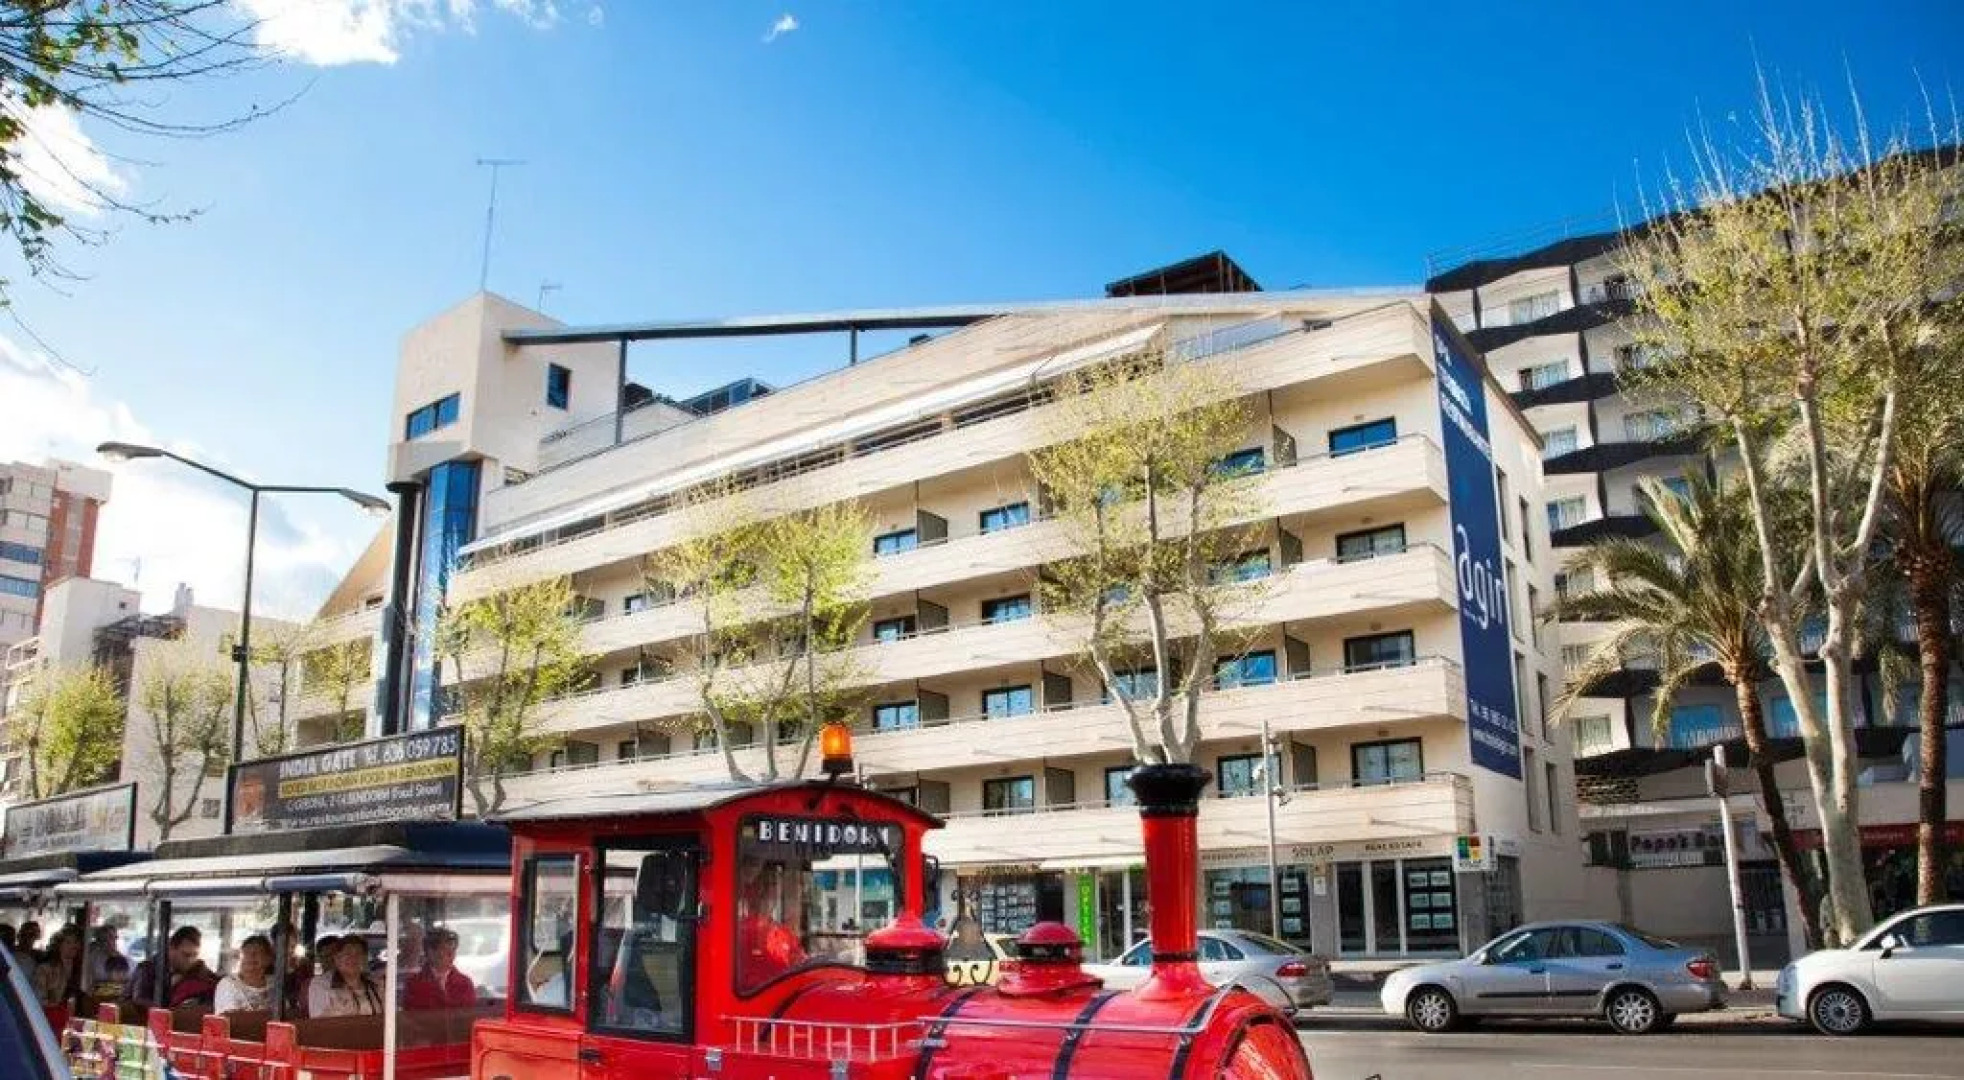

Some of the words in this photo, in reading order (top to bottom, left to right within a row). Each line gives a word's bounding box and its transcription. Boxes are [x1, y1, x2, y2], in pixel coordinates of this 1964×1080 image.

[279, 753, 316, 778] INDIA
[321, 749, 356, 773] GATE
[406, 738, 429, 760] 059
